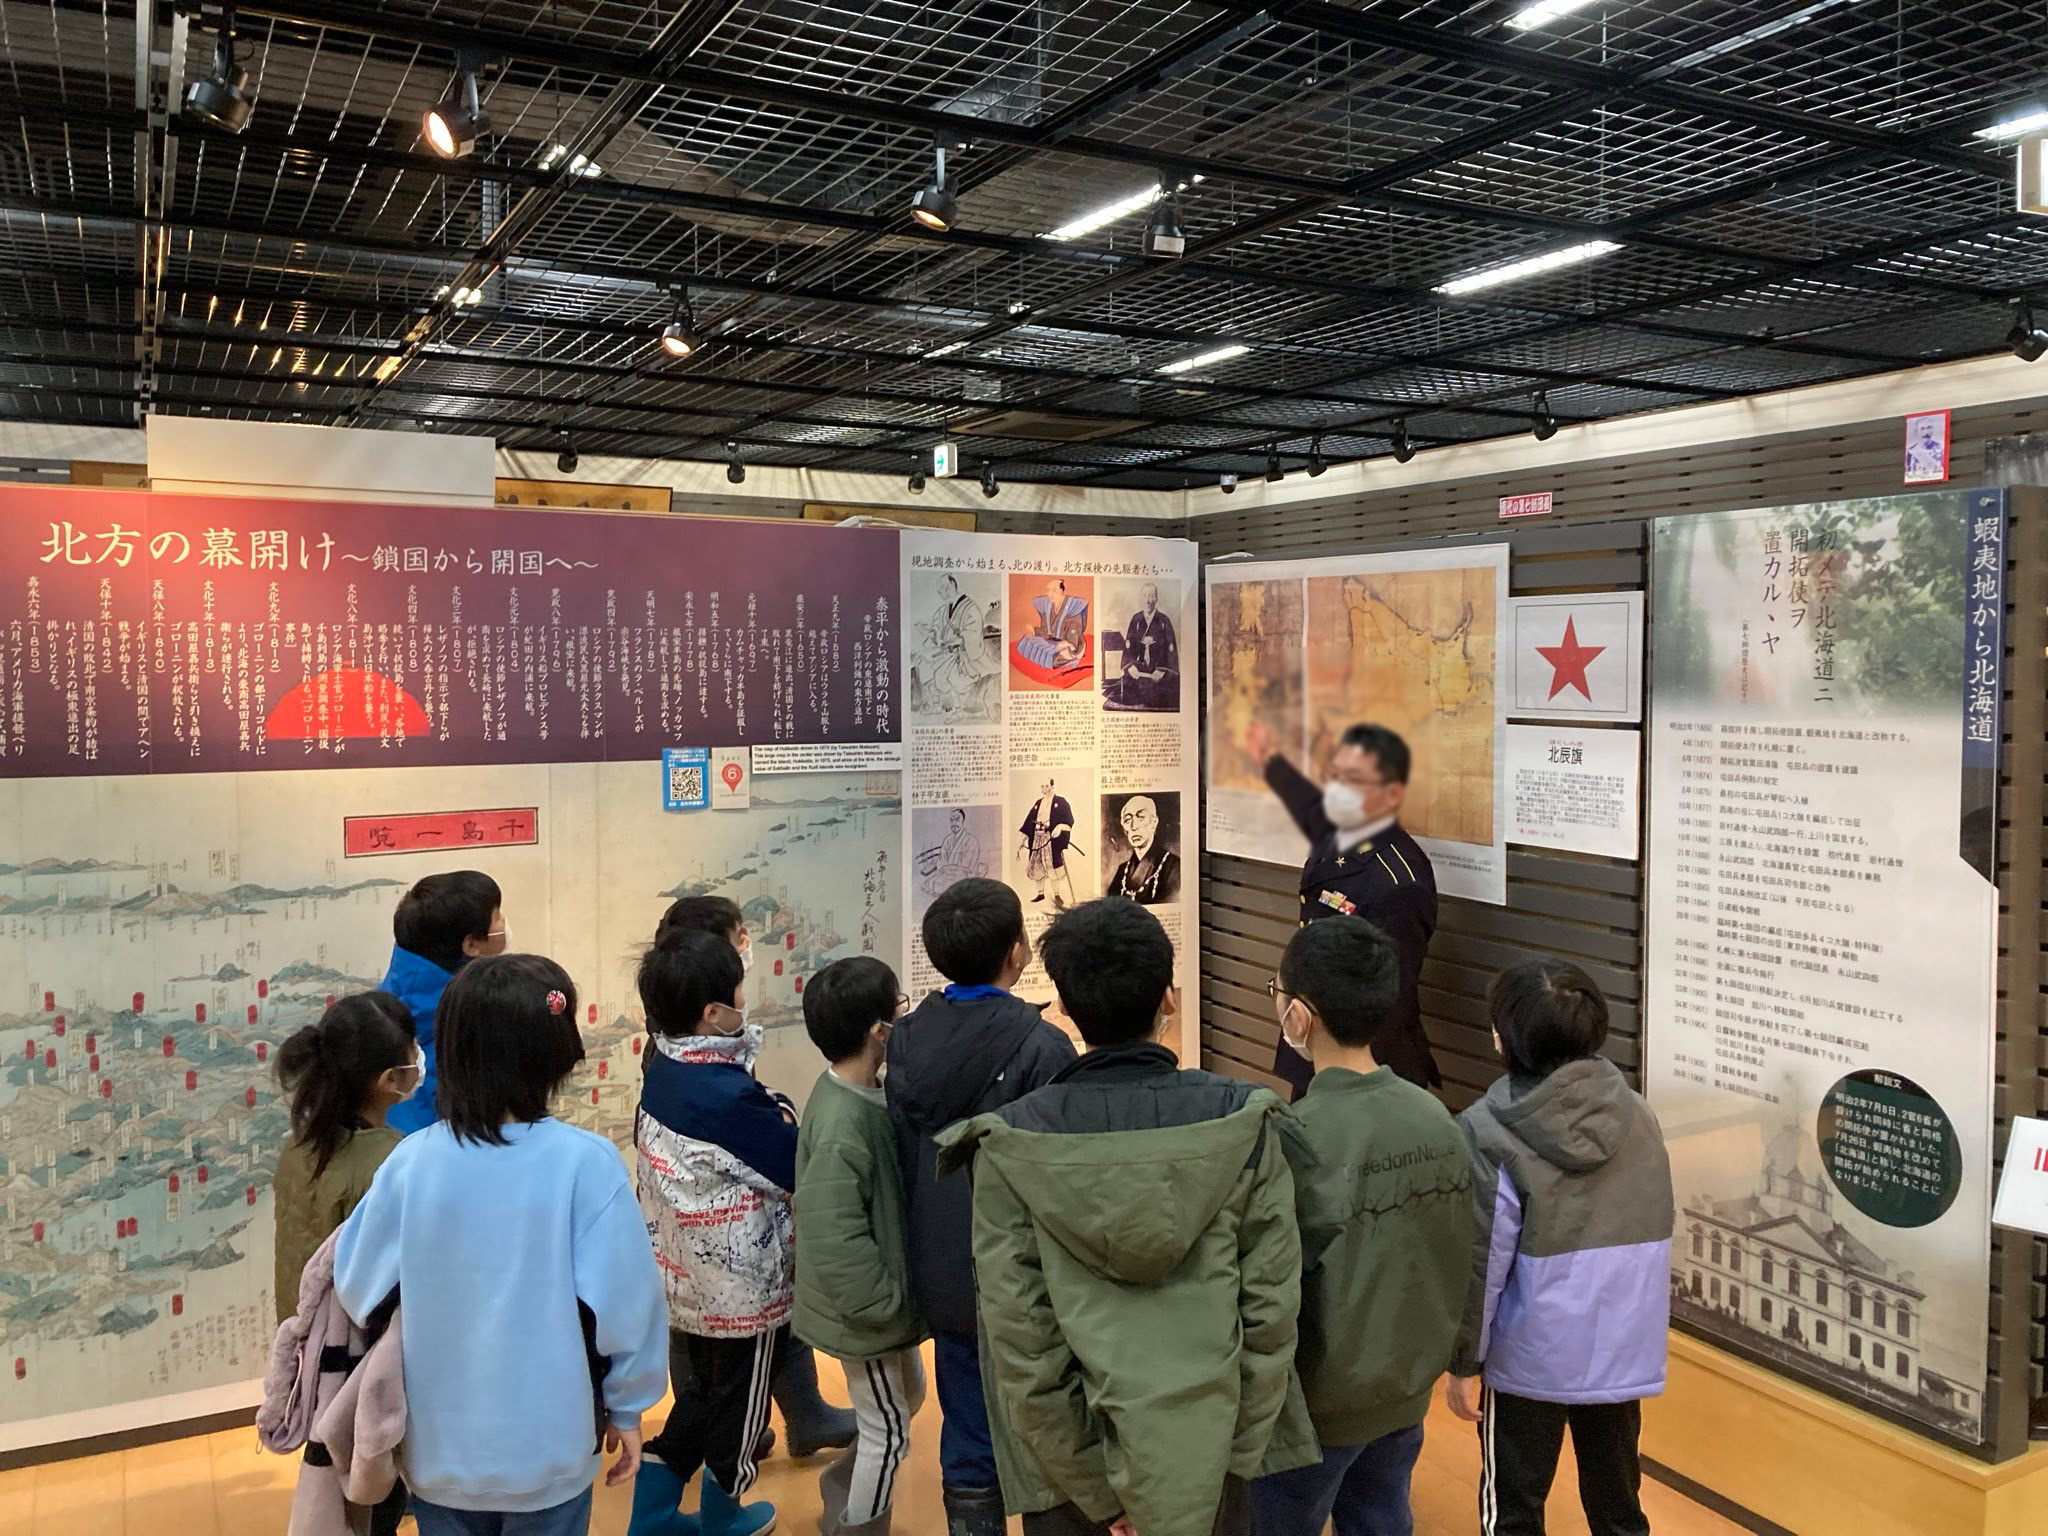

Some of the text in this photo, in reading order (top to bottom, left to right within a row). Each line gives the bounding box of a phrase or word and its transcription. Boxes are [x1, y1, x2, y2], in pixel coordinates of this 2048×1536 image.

[1788, 529, 1808, 629] 開拓使ヲ
[1967, 517, 2000, 742] 蝦夷地から北海道
[875, 596, 890, 734] 泰平から激動の時代
[1010, 754, 1038, 762] 伊能忠敬
[1548, 746, 1583, 764] 北辰旗
[728, 768, 738, 780] 6
[1101, 776, 1128, 784] 最上徳内
[1874, 1074, 1902, 1089] 解説文
[1836, 1170, 1882, 1192] なりました。
